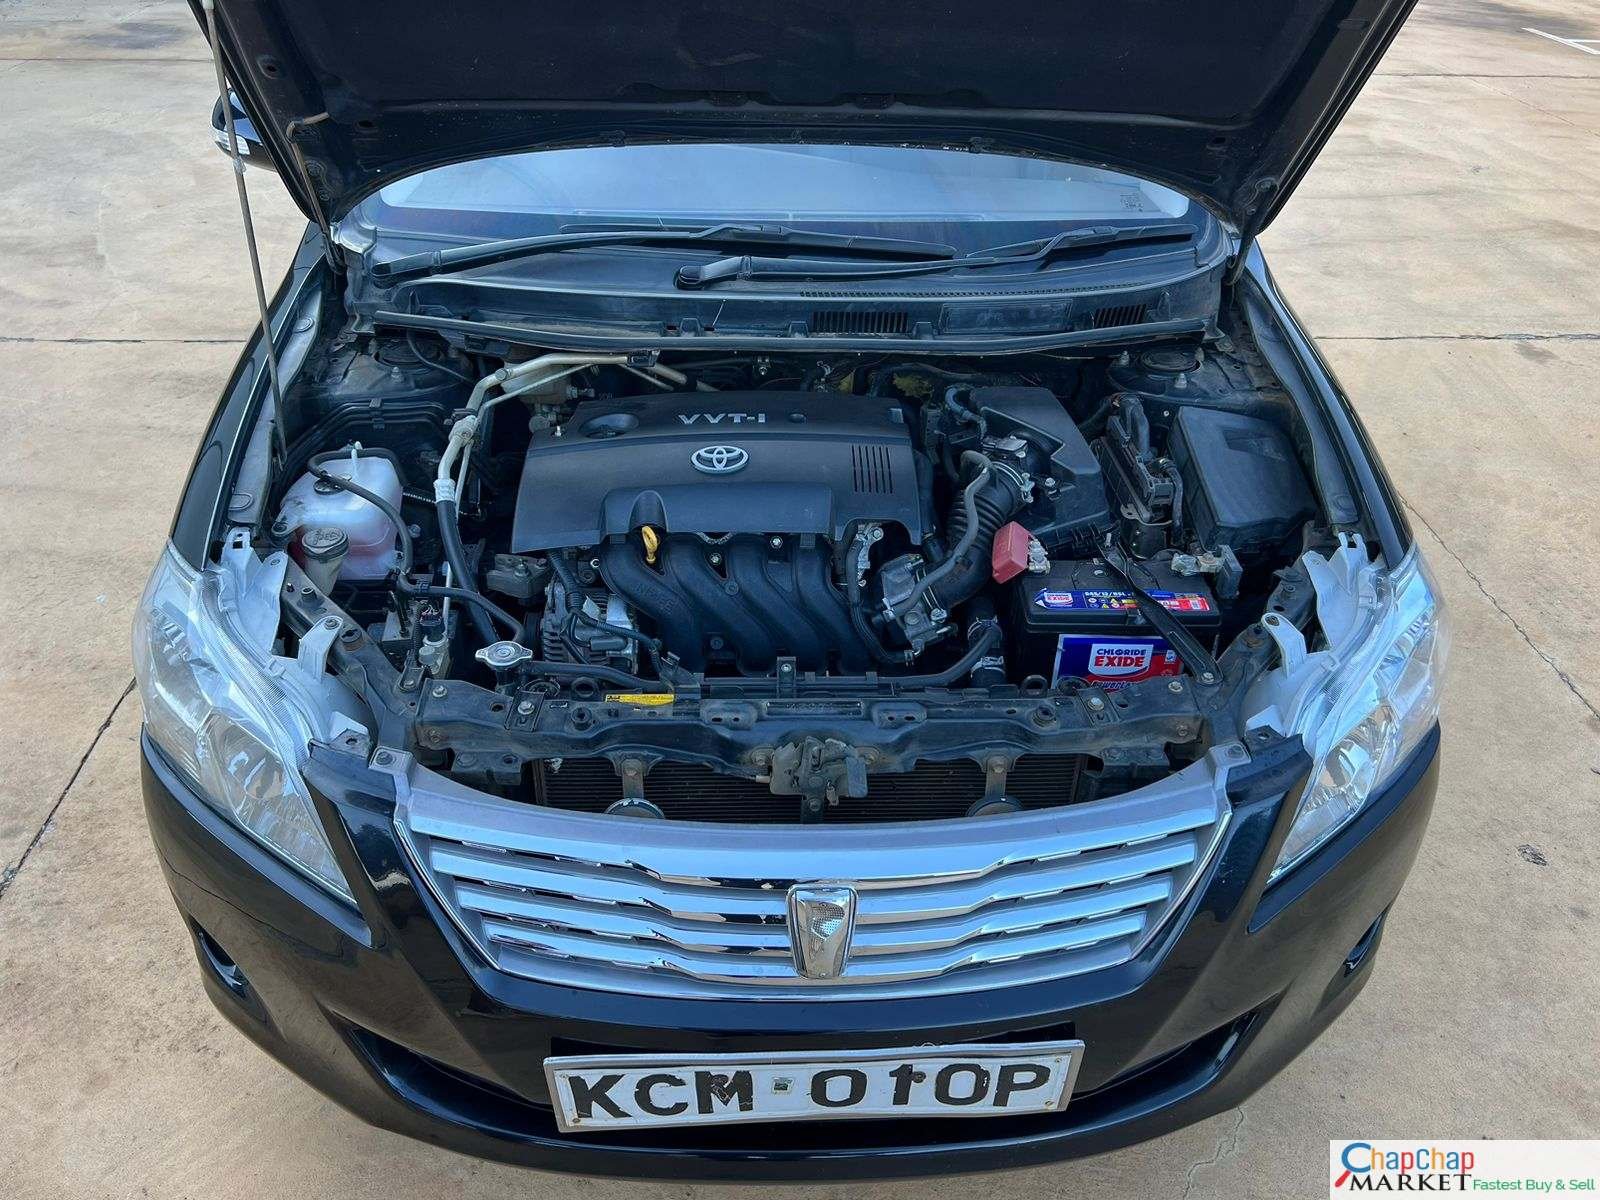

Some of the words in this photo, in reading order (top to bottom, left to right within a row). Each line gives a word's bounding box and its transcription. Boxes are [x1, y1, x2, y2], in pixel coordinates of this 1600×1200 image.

[1096, 648, 1147, 656] CHLORIDE
[1094, 656, 1146, 667] EXIDE
[568, 1070, 755, 1118] KCM
